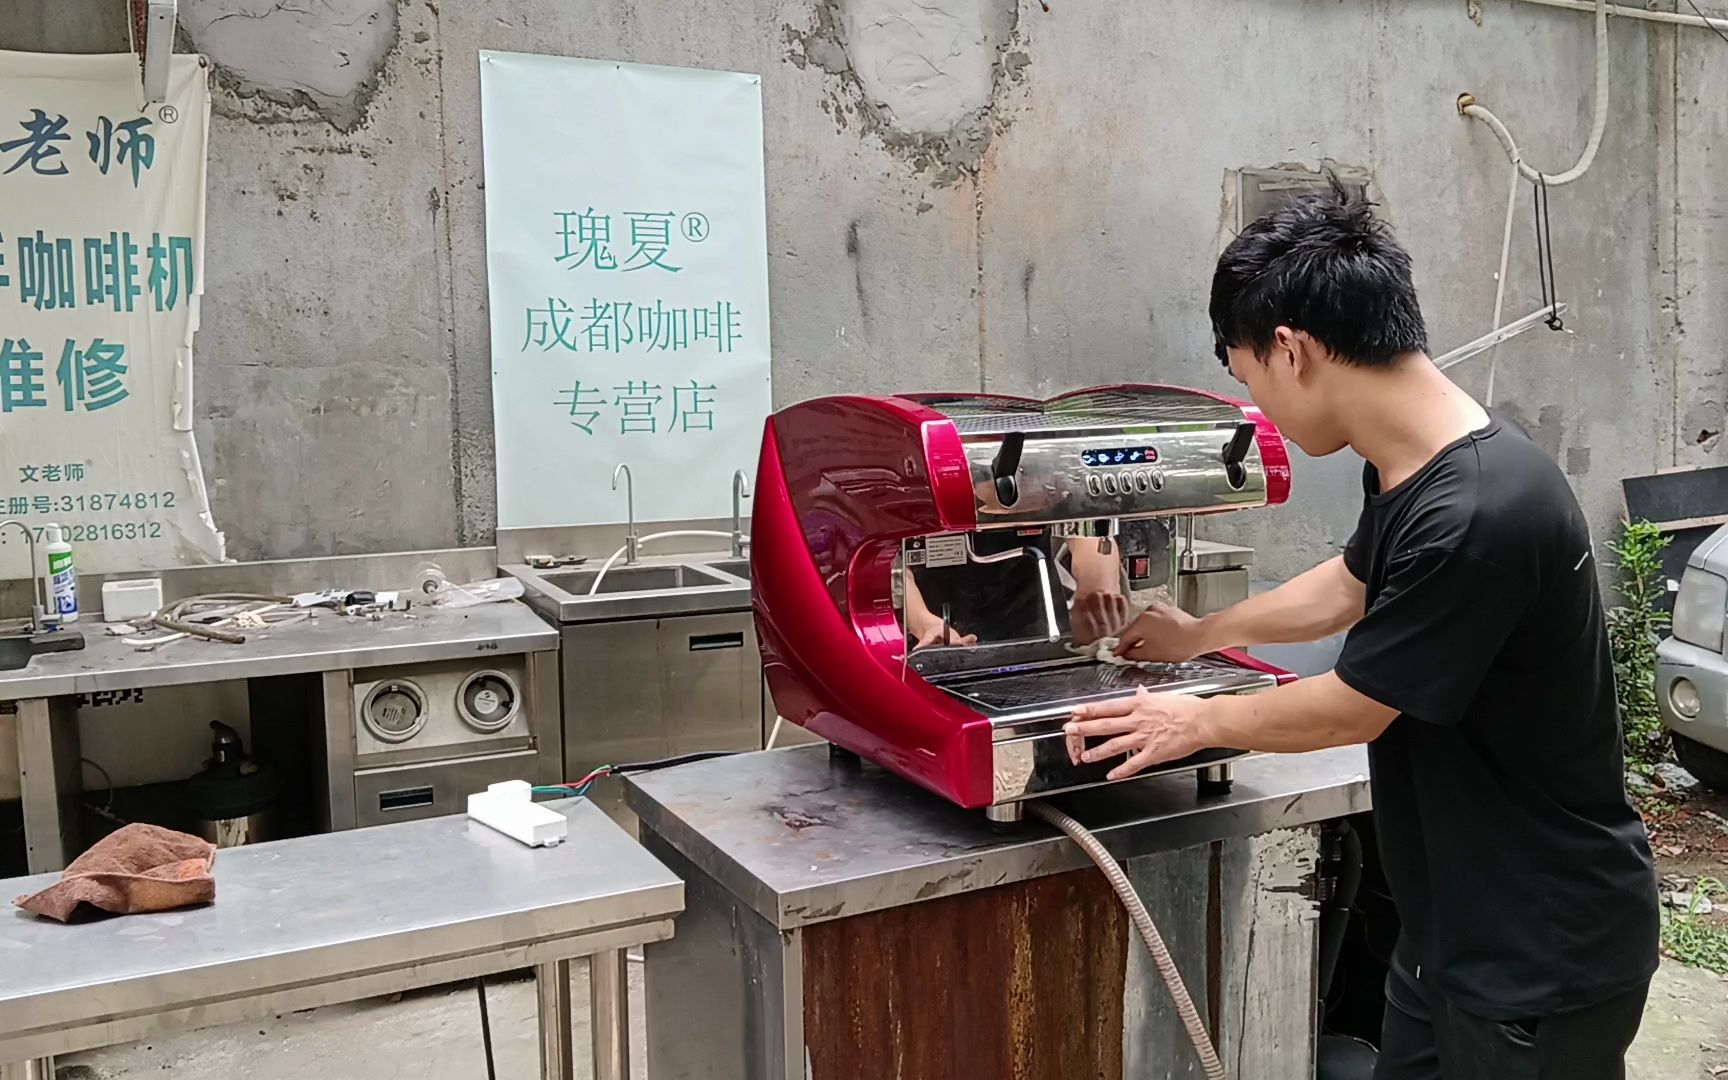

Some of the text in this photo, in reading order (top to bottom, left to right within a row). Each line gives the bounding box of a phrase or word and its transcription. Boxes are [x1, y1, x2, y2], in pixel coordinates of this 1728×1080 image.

[0, 230, 193, 312] 咖啡机
[521, 297, 743, 353] 成都咖啡
[553, 379, 717, 435] 专营店
[19, 464, 84, 483] 文老师
[21, 522, 161, 543] 1702816312
